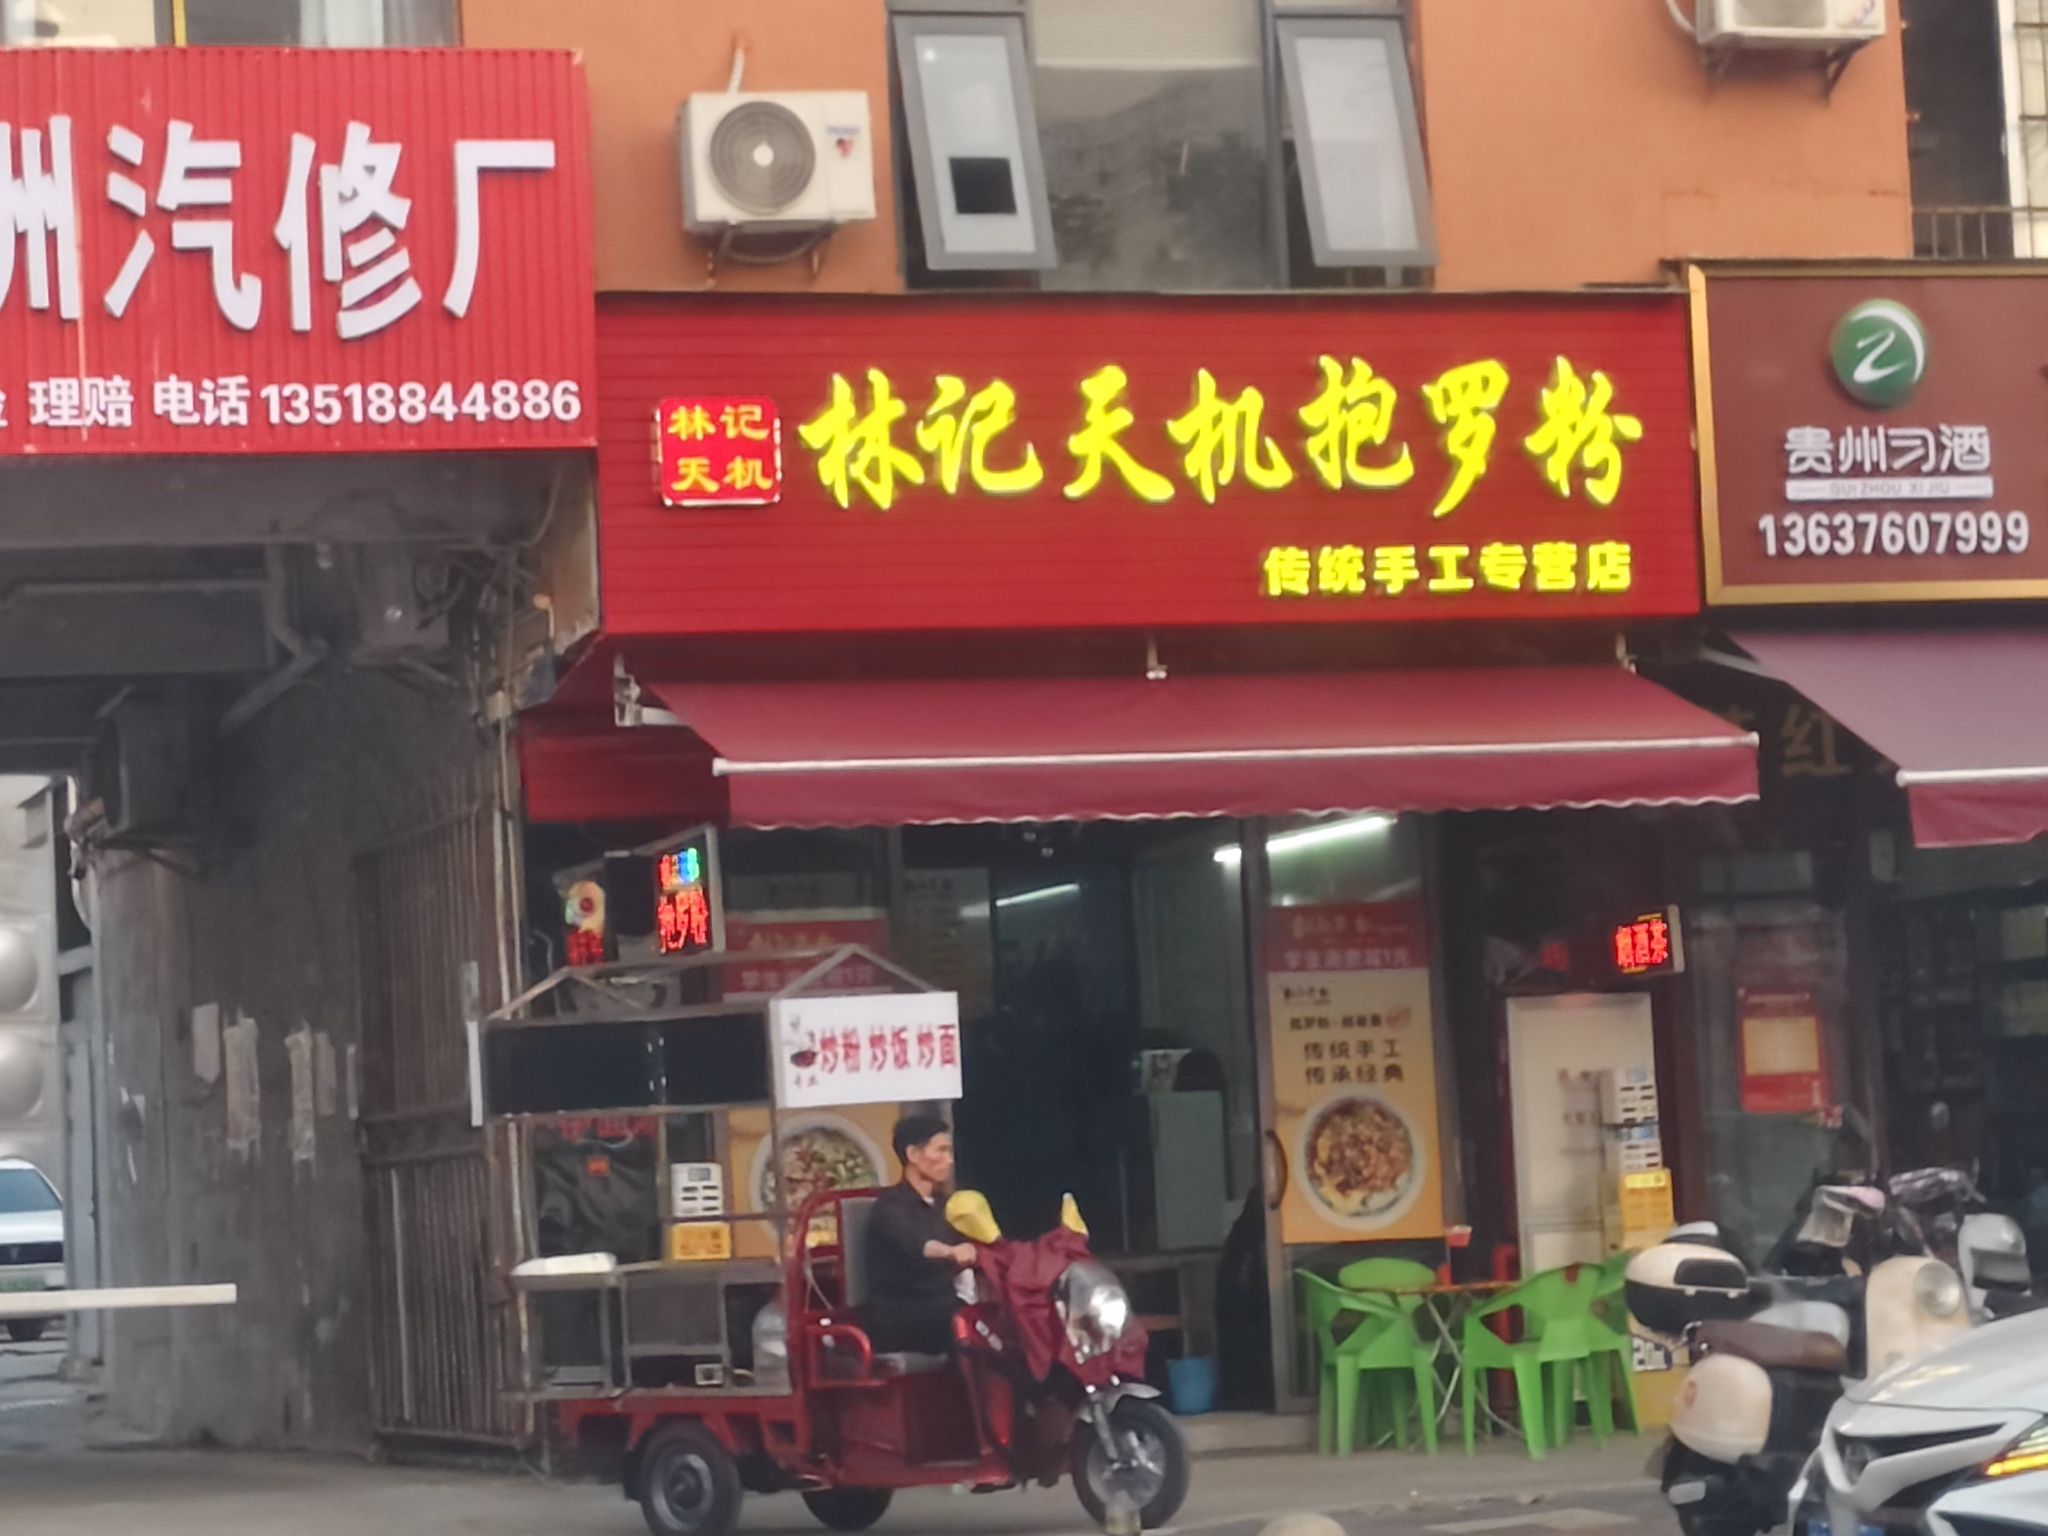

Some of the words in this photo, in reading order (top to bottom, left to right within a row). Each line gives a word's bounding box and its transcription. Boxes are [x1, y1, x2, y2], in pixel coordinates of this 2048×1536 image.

[28, 376, 133, 427] 理赔
[153, 375, 251, 426] 电话
[260, 379, 582, 424] 13518844886
[666, 403, 771, 442] 林记
[798, 354, 1643, 518] 林记天机抱罗粉
[1785, 424, 1991, 474] 贵州习酒
[669, 455, 773, 493] 天机
[1830, 483, 1857, 496] GUI
[1860, 483, 1901, 495] ZHOU
[1759, 511, 2030, 556] 13637607999
[1262, 540, 1633, 597] 传统手工专营店
